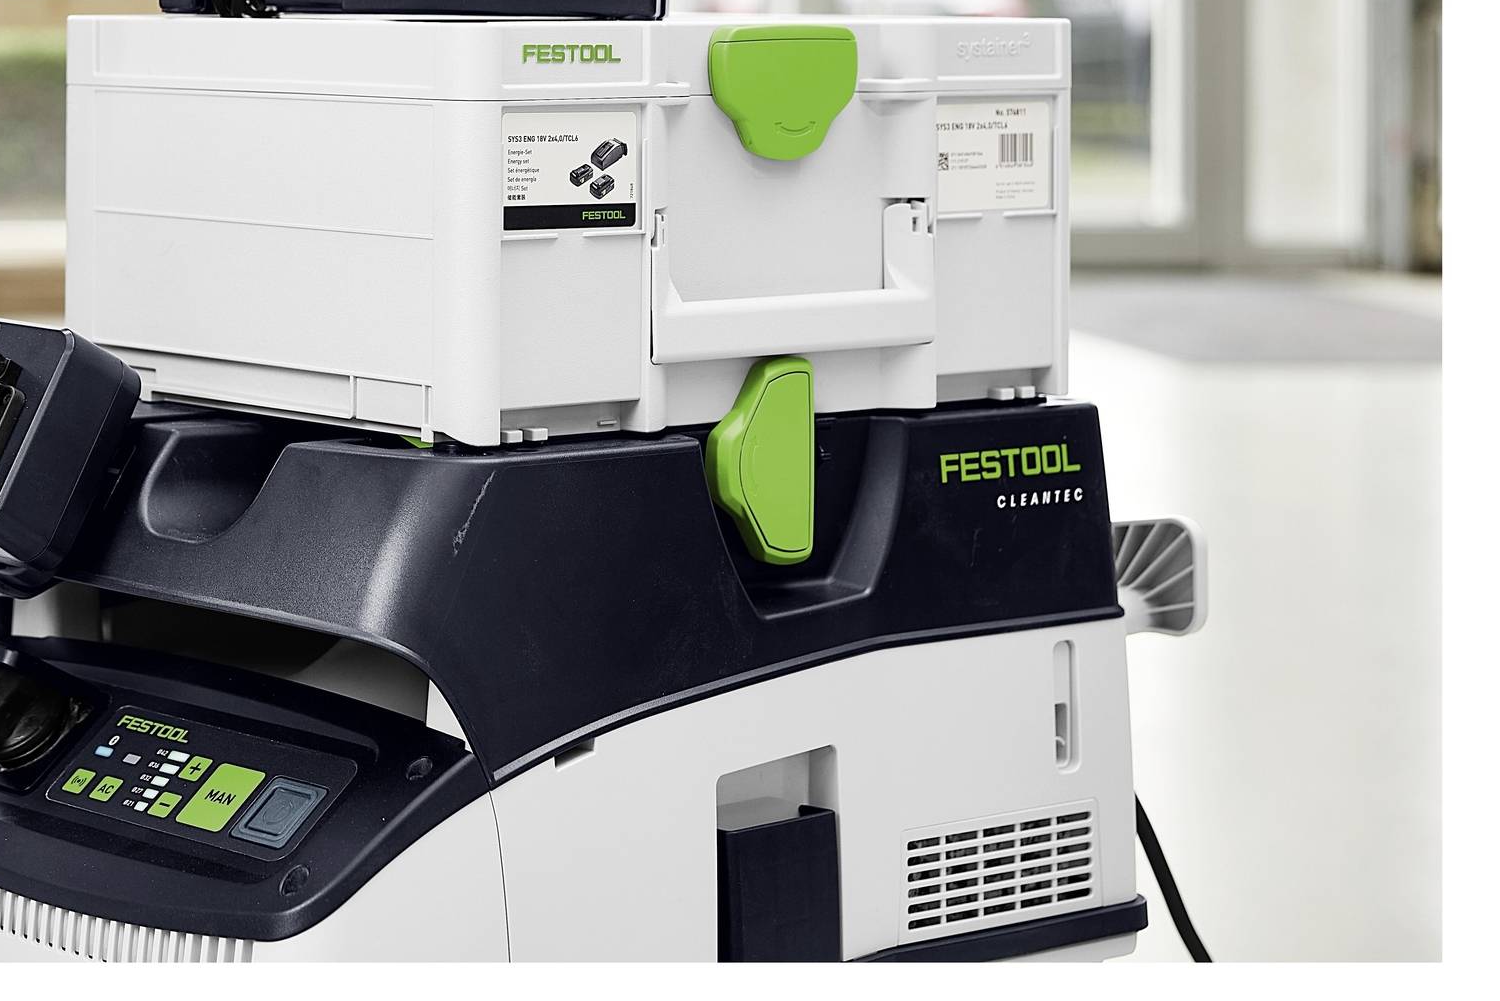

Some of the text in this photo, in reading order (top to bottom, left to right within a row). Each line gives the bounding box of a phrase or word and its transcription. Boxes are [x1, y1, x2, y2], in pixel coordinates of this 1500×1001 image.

[522, 44, 621, 64] FESTOOL
[507, 135, 522, 143] SYS3
[582, 210, 626, 220] FESTOOL
[940, 443, 1081, 484] FESTOOL
[996, 487, 1083, 509] CLEANTEC
[116, 714, 189, 744] FESTOOL
[96, 783, 115, 795] AC
[204, 788, 237, 806] MAN
